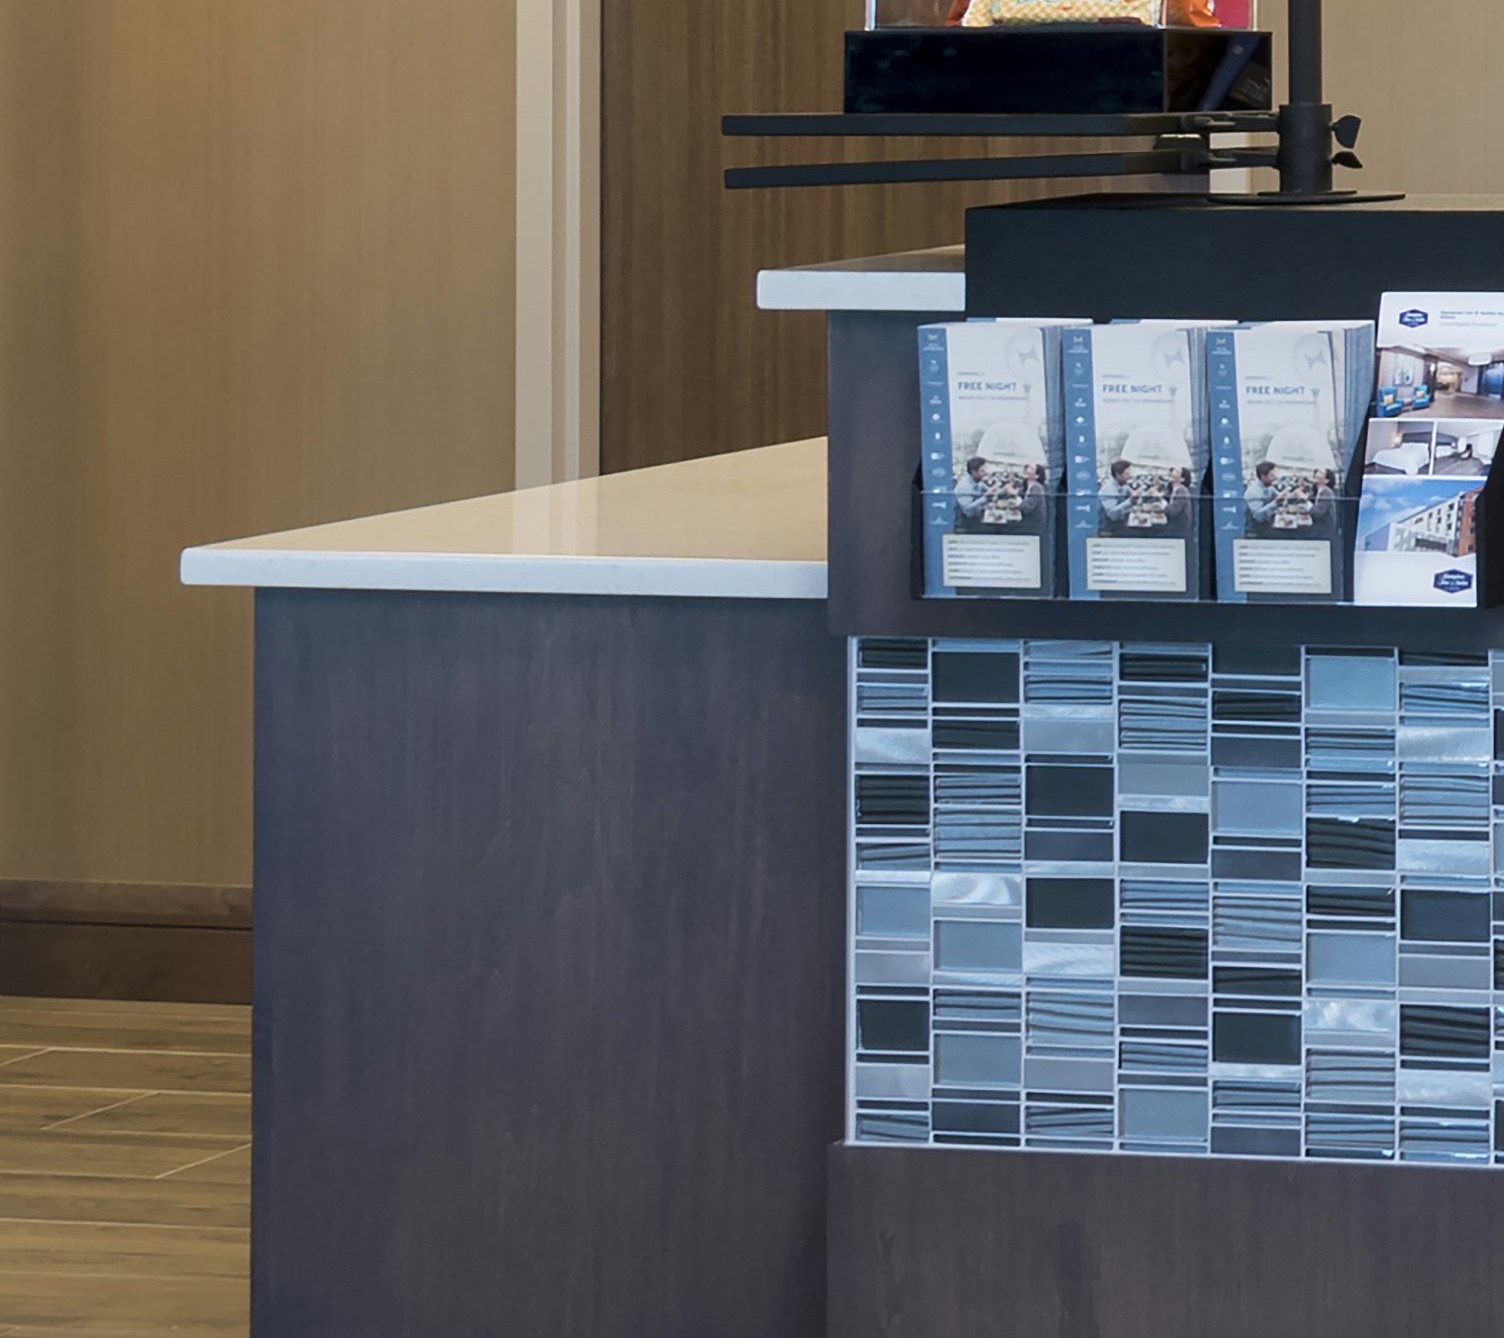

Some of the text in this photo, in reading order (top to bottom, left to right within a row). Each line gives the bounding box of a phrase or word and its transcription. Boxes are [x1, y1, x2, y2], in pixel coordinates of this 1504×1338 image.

[957, 381, 1018, 391] FREE NIGHT
[1102, 384, 1163, 394] FREE NIGHT
[1245, 385, 1305, 396] FREE NIGHT
